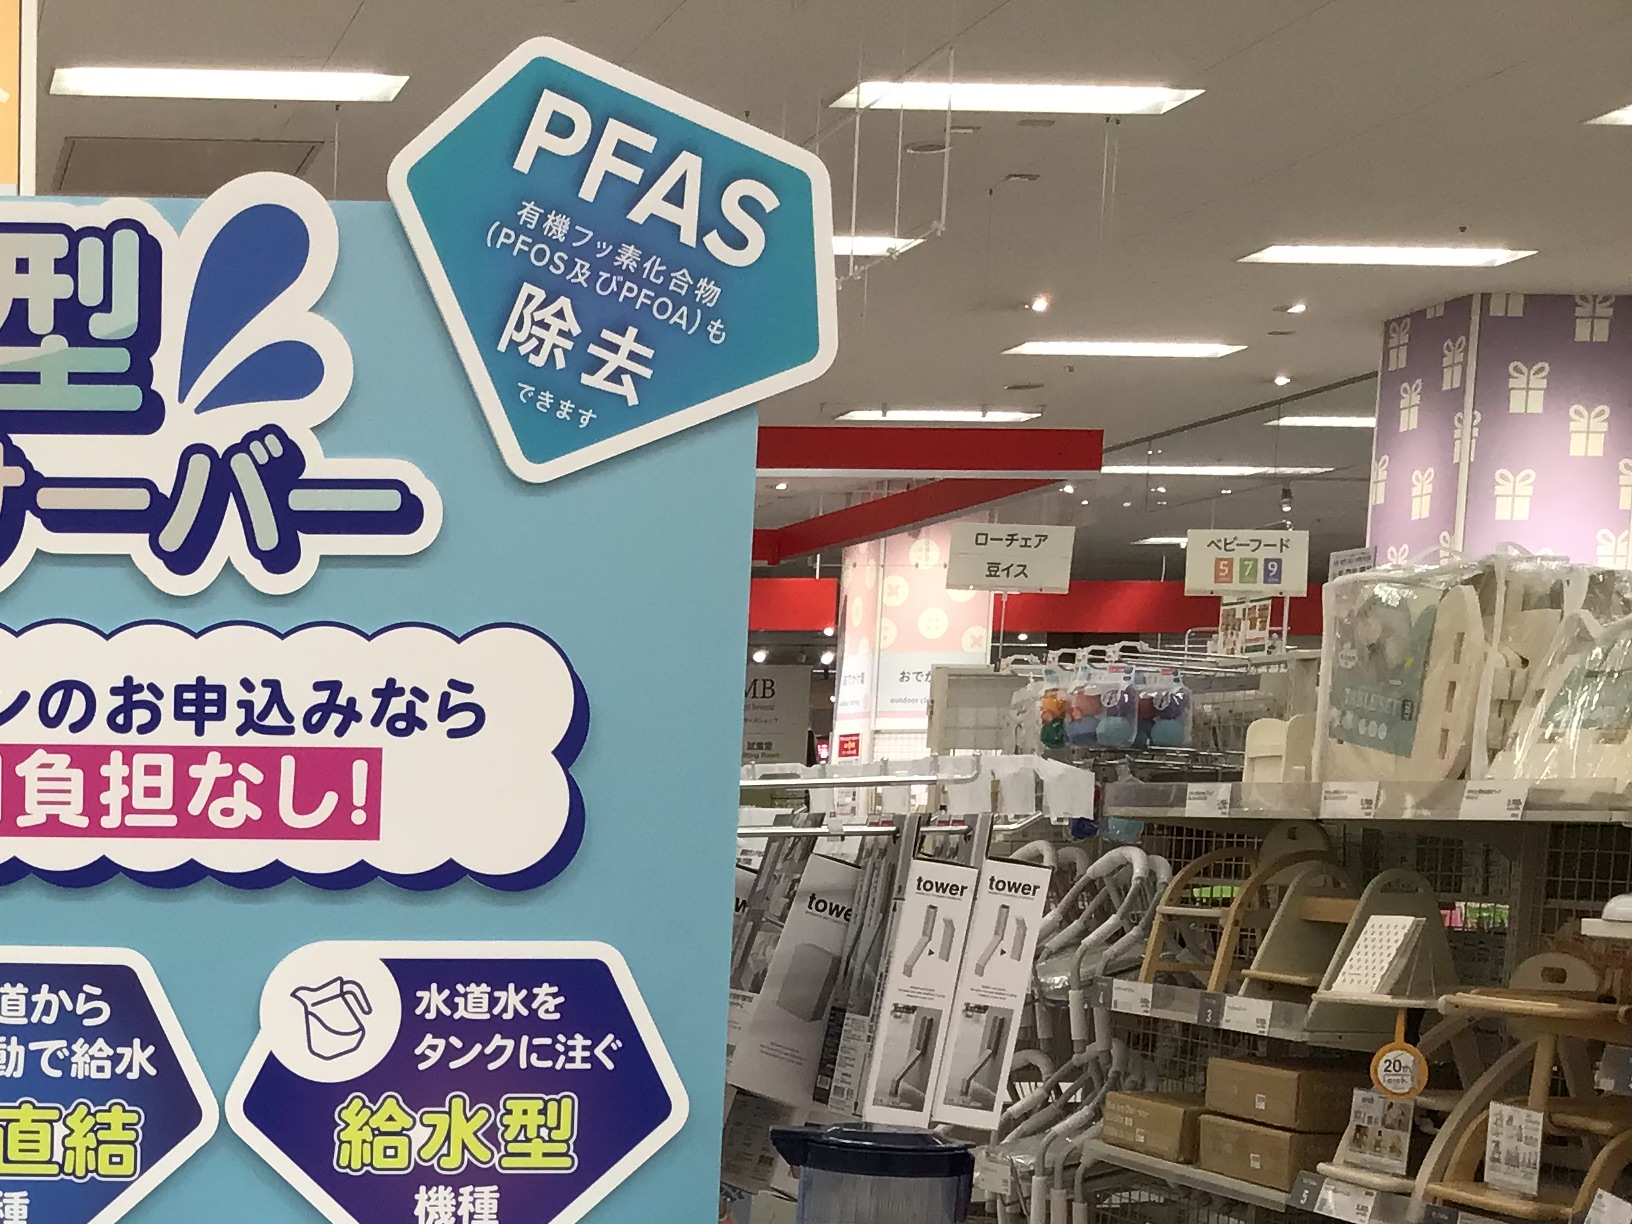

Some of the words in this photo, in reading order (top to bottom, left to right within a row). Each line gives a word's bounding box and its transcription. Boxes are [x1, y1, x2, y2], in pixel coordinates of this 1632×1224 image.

[512, 88, 781, 267] PFAS
[517, 200, 722, 307] 有機フッ素化合物
[497, 282, 655, 406] 除去
[516, 382, 597, 428] できます
[975, 532, 1049, 548] ローチェア
[1207, 536, 1290, 553] ベビーフード
[985, 562, 1029, 579] 豆イス
[1219, 560, 1229, 576] 5
[1244, 559, 1254, 576] 7
[1268, 561, 1278, 577] 9
[915, 875, 968, 898] tower
[988, 875, 1041, 899] tower
[414, 982, 566, 1020] 水道水を
[1205, 1008, 1213, 1023] 3
[414, 1032, 623, 1071] タンクに注ぐ
[336, 1094, 577, 1174] 給水型
